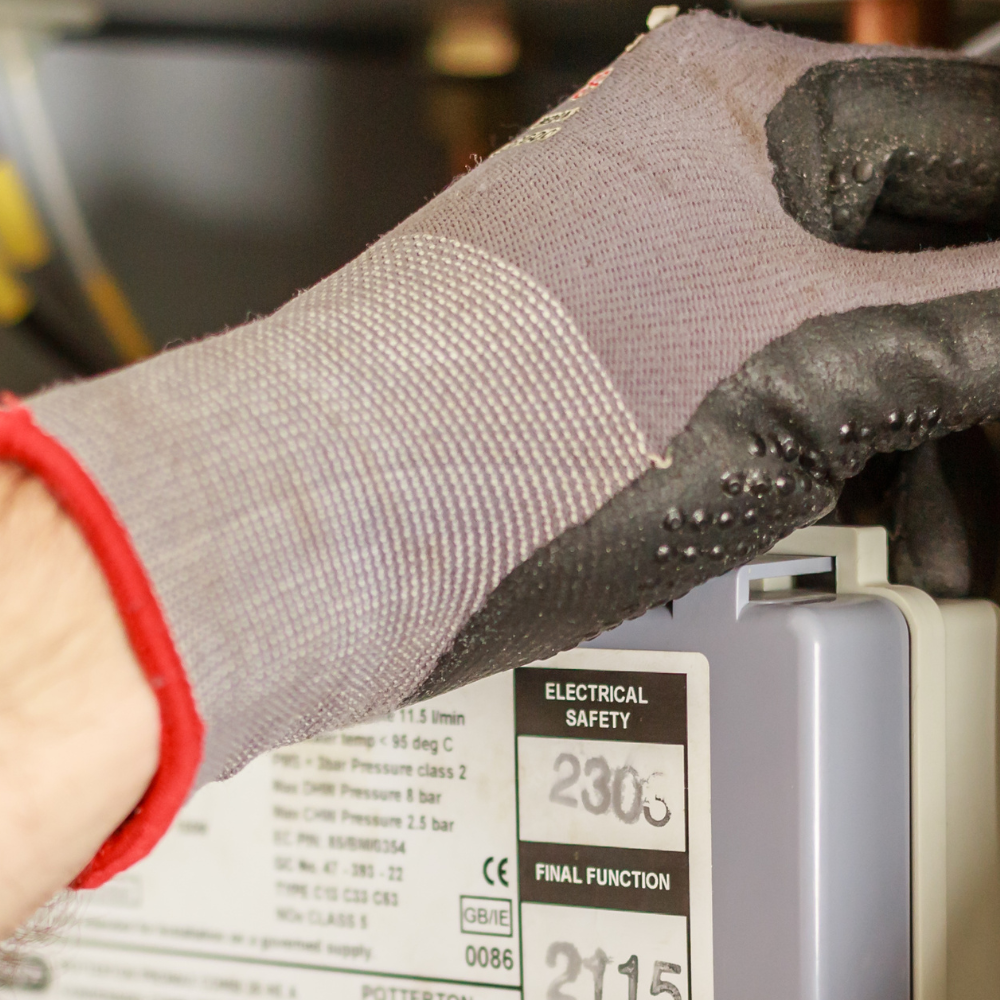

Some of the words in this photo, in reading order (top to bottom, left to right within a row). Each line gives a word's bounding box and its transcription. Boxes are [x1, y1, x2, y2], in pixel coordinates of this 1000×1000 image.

[545, 682, 648, 704] ELECTRICAL
[400, 708, 427, 725] 11.5
[431, 709, 466, 726] l/min
[565, 709, 631, 729] SAFETY
[412, 736, 438, 755] deg
[442, 737, 453, 752] C
[351, 757, 413, 777] Pressure
[417, 761, 454, 779] class
[459, 765, 467, 780] 2
[341, 783, 402, 803] Pressure
[419, 789, 442, 804] bar
[341, 809, 402, 828] Pressure
[408, 815, 427, 830] 2.5
[432, 816, 454, 833] bar
[535, 863, 582, 884] FINAL
[586, 867, 670, 891] FUNCTION
[464, 906, 510, 928] GB/IE
[465, 945, 514, 970] 0086
